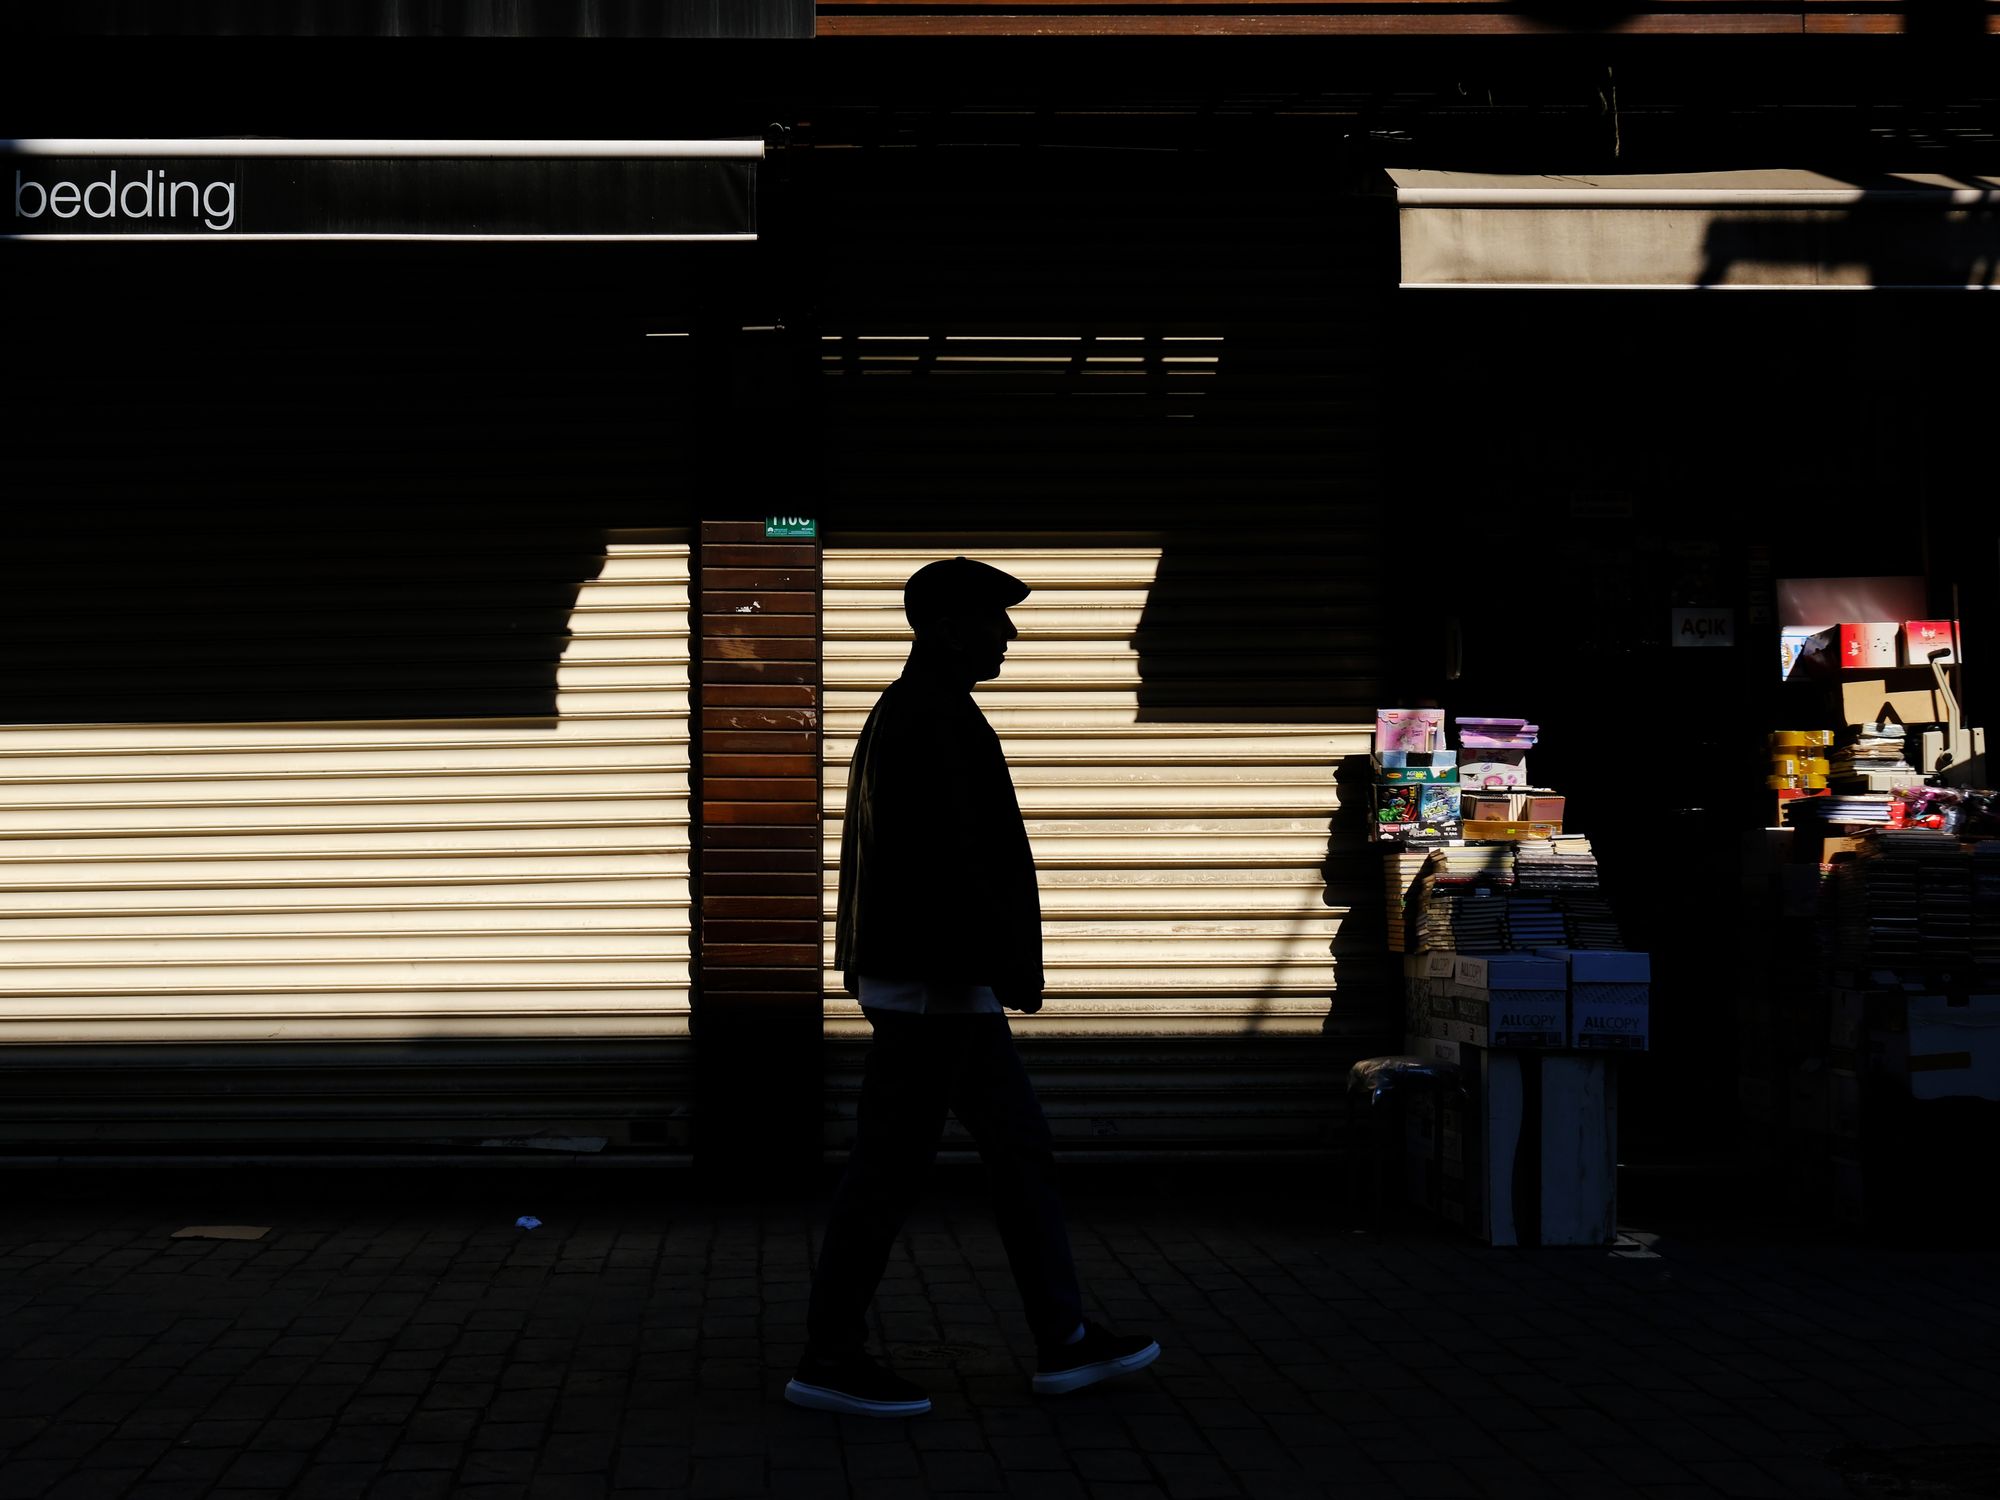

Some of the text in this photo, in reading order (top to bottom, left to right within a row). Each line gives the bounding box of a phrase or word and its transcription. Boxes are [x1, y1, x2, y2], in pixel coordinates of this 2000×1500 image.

[15, 169, 235, 231] bedding
[1681, 619, 1726, 638] AÇIK
[1500, 1014, 1556, 1026] ALLCOPY
[1584, 1016, 1640, 1029] ALLCOPY
